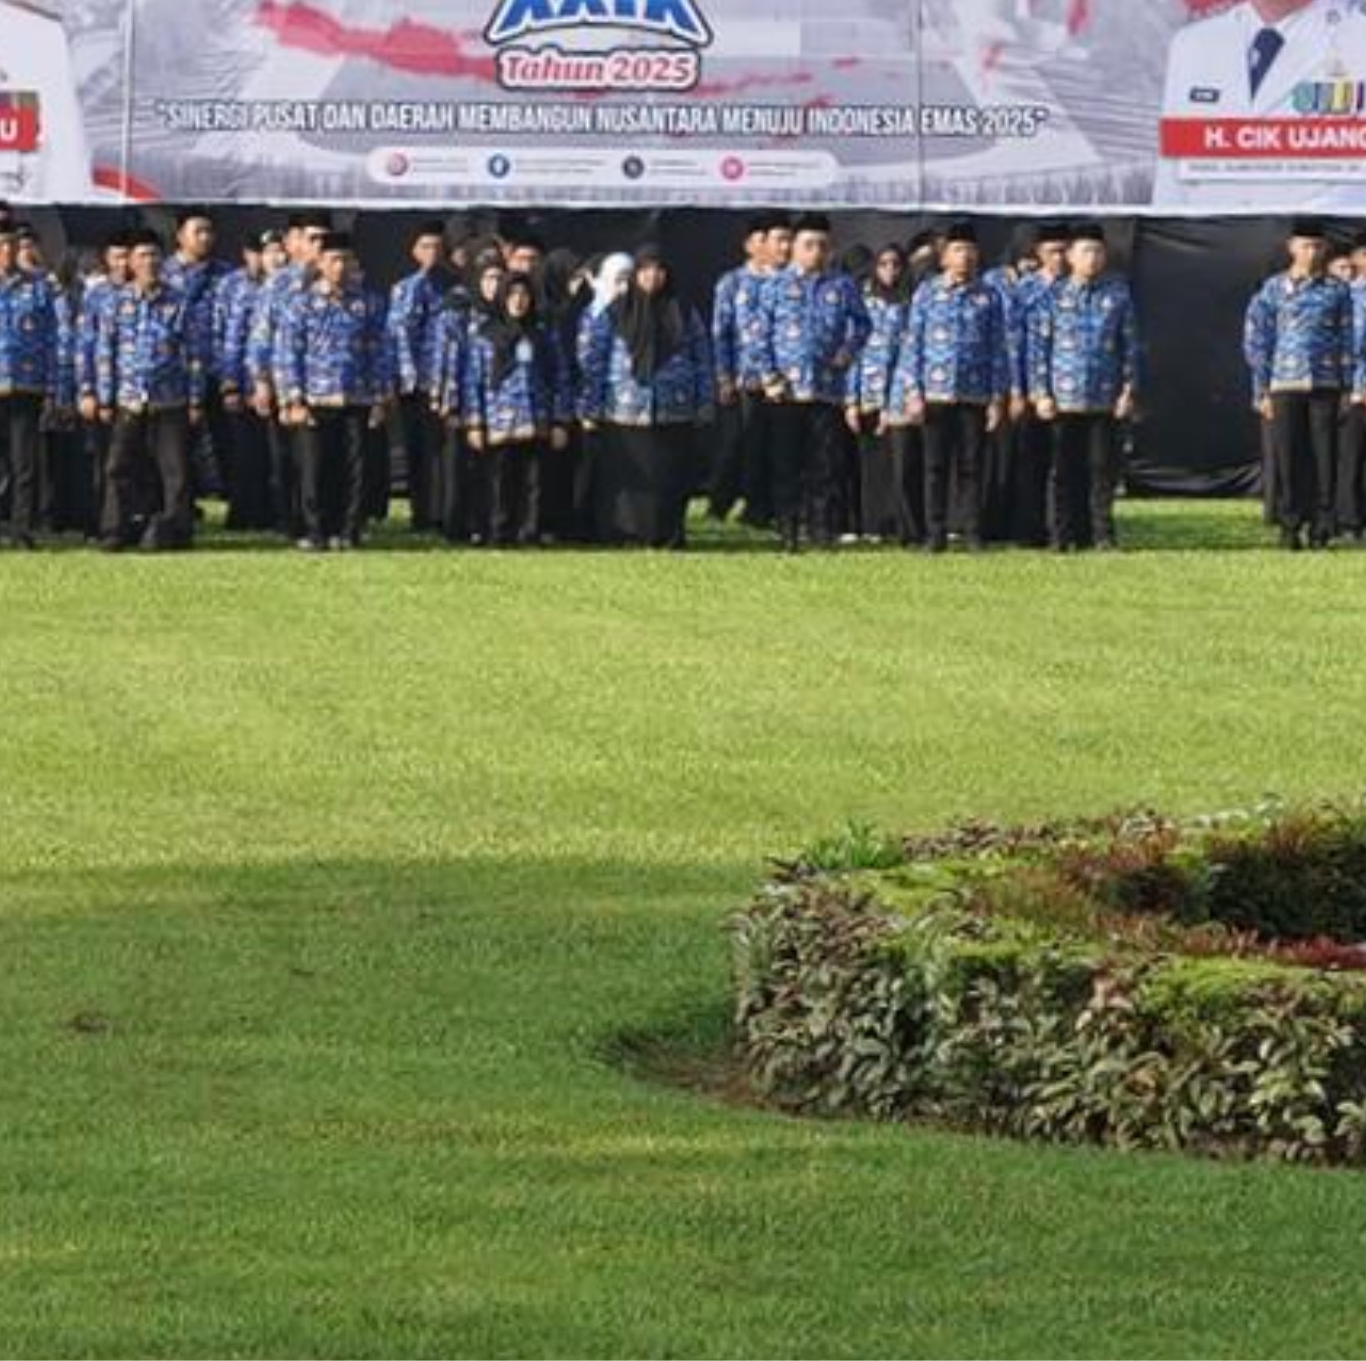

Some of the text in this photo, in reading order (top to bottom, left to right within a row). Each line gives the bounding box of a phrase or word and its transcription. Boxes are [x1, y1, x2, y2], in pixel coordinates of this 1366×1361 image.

[506, 54, 690, 82] Tahun 2025
[252, 102, 317, 129] PUSAT
[323, 103, 366, 129] DAN
[371, 103, 453, 130] DAERAH
[460, 104, 590, 131] MEMBANGUN
[596, 105, 717, 132] NUSANTARA
[722, 106, 803, 133] MENUJU
[808, 106, 915, 134] INDONESIA
[921, 107, 978, 134] EMAS
[1204, 127, 1232, 149] H.
[1237, 126, 1282, 149] CIK
